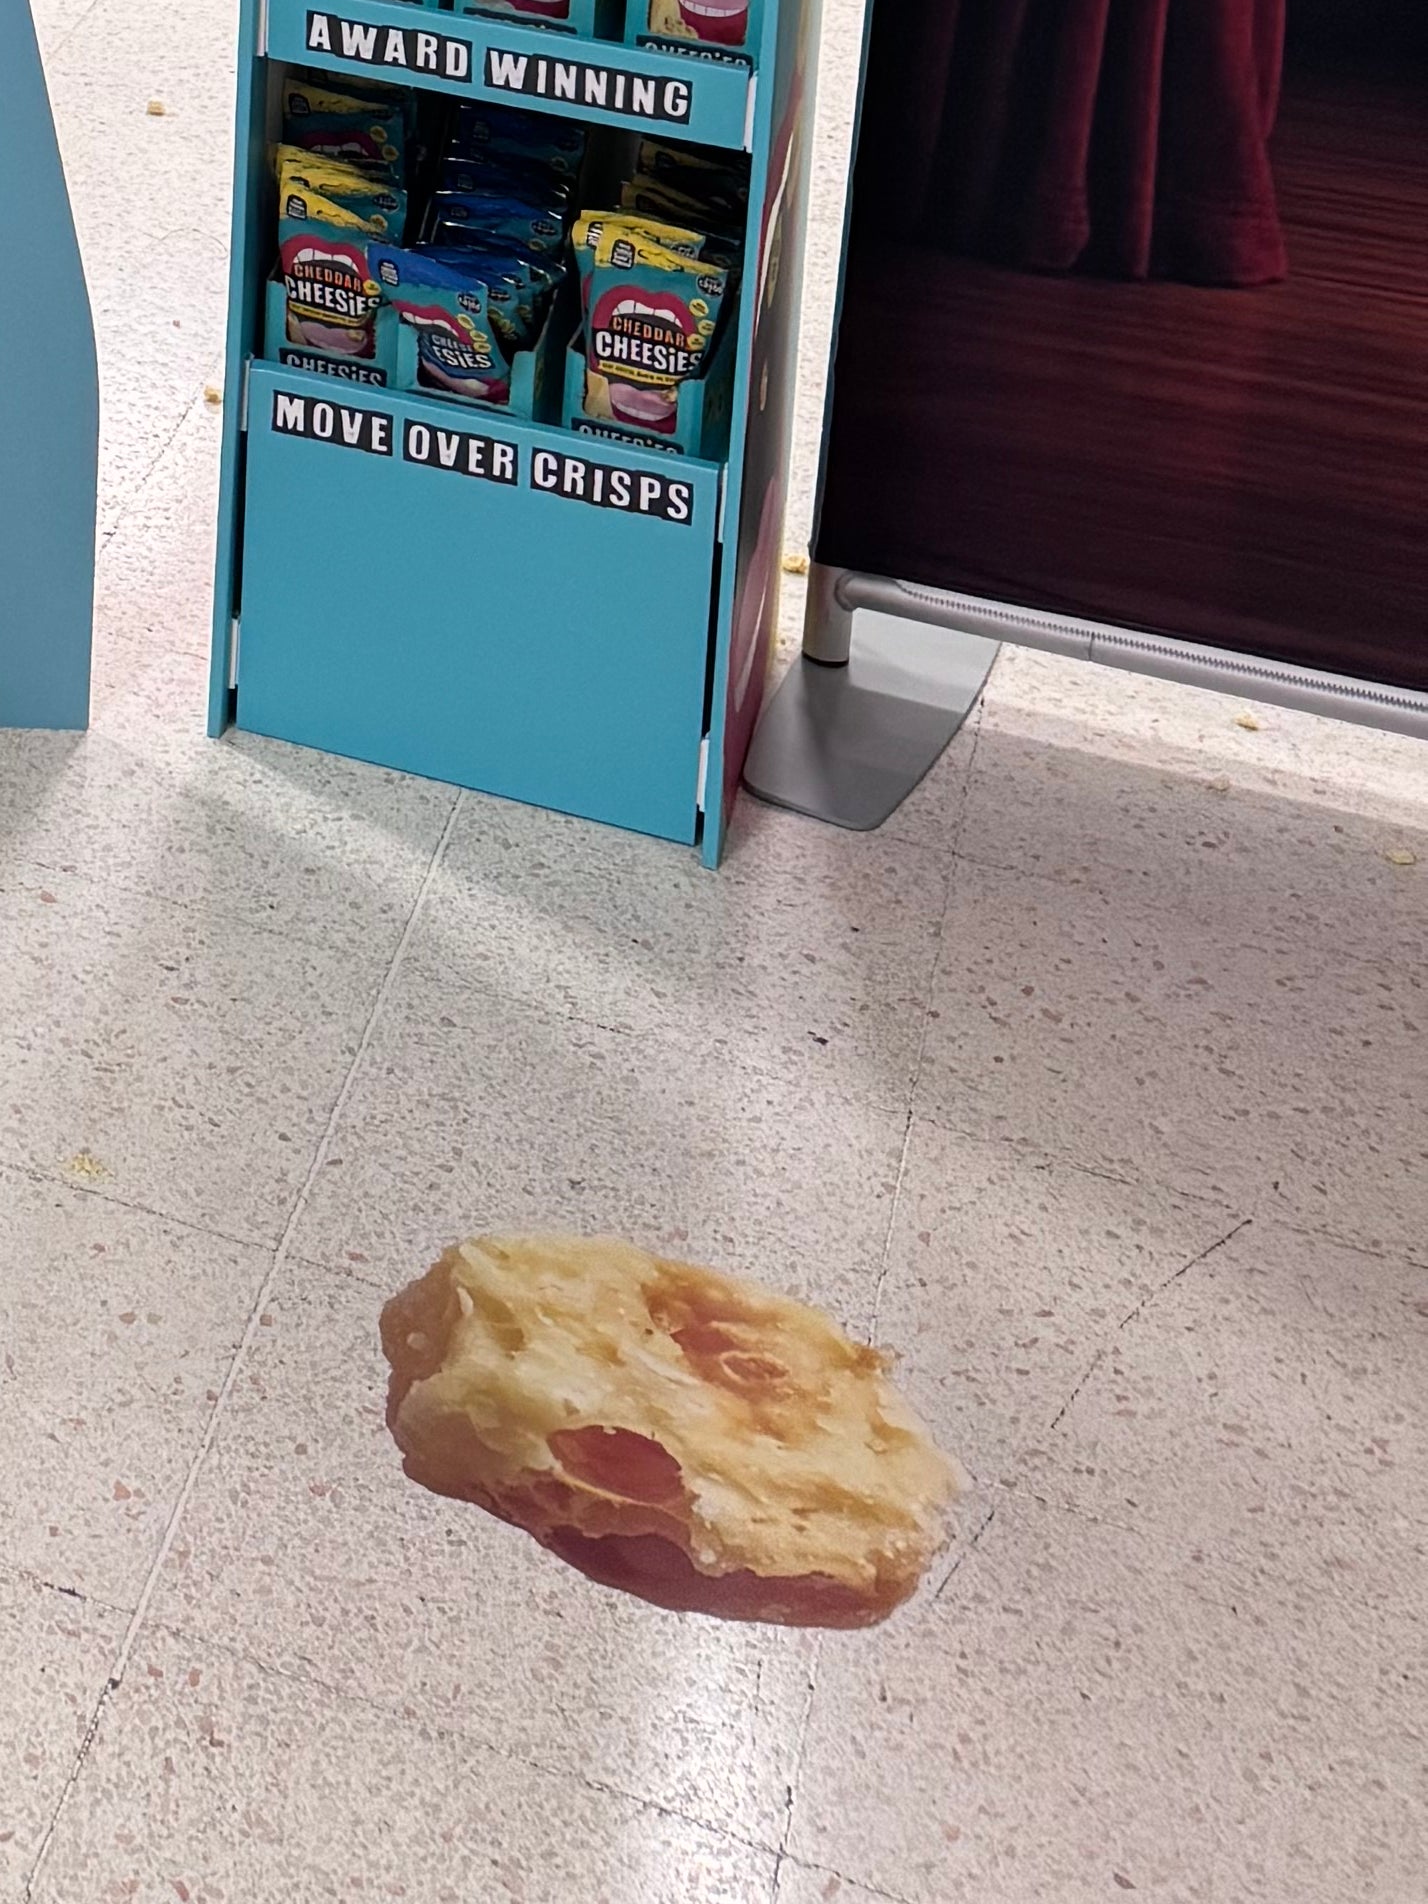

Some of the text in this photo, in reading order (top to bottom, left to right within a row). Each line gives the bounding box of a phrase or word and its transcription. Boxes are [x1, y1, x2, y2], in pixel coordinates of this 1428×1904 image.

[309, 13, 689, 117] AWARD WINNING
[294, 263, 362, 292] CHEDDAR
[612, 316, 685, 346] CHEDDAR
[276, 394, 389, 452] MOVE
[407, 423, 515, 481] OVER
[534, 450, 690, 520] CRISPS
